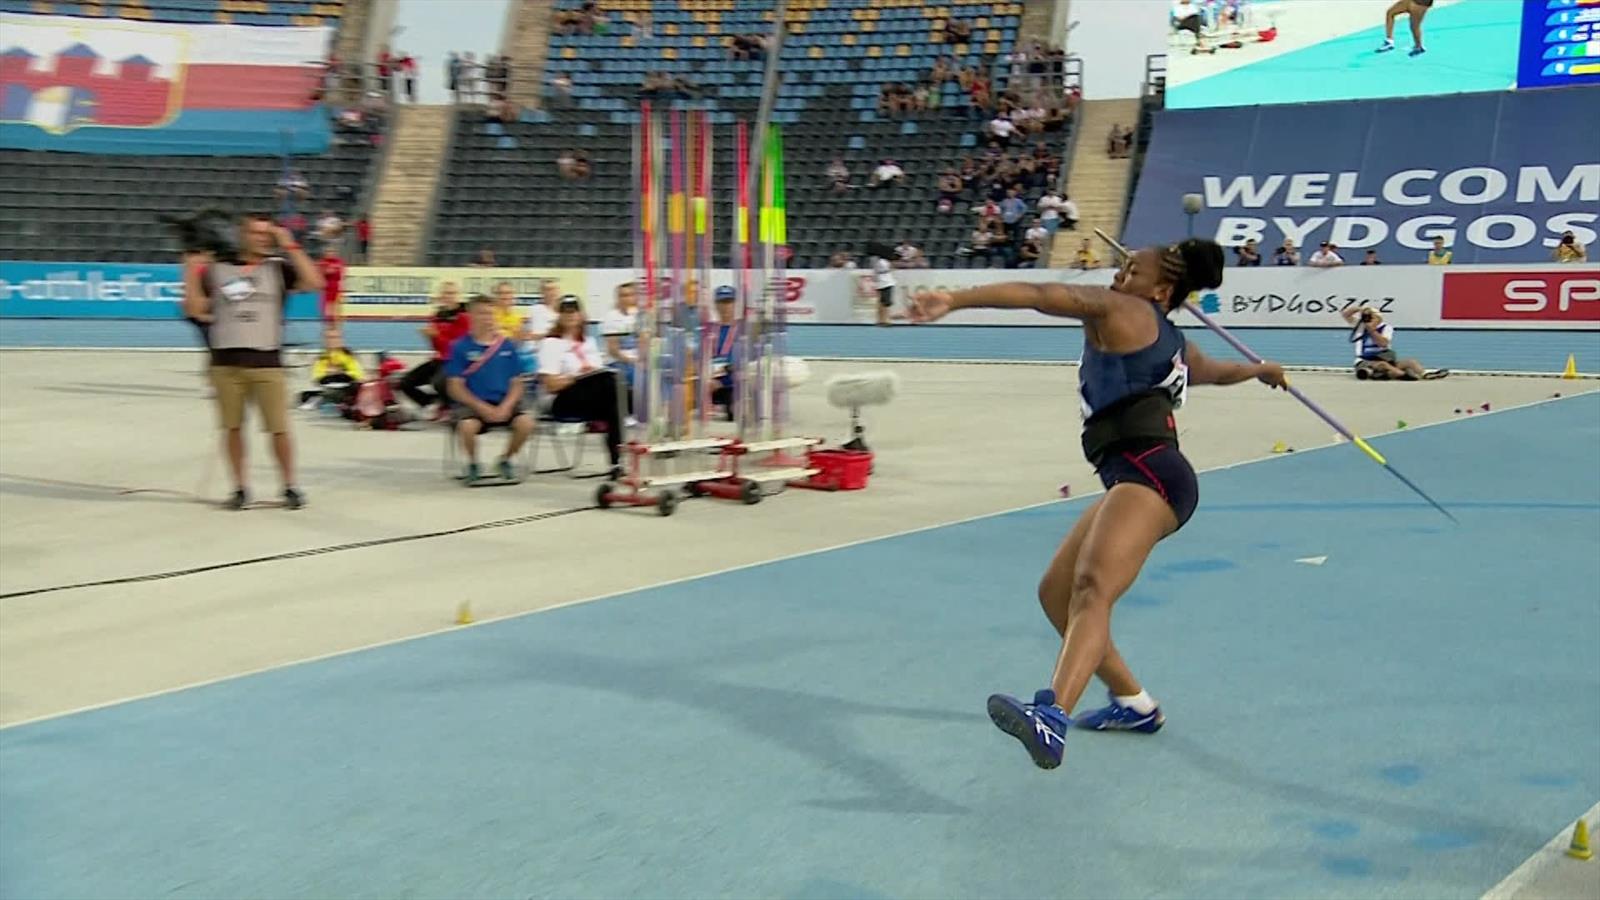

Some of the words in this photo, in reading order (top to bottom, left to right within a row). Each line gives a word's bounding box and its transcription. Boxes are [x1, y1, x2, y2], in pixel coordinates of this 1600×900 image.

[1203, 164, 1600, 207] WELCOM
[1215, 213, 1599, 250] BYDGOS
[1503, 279, 1600, 312] SP
